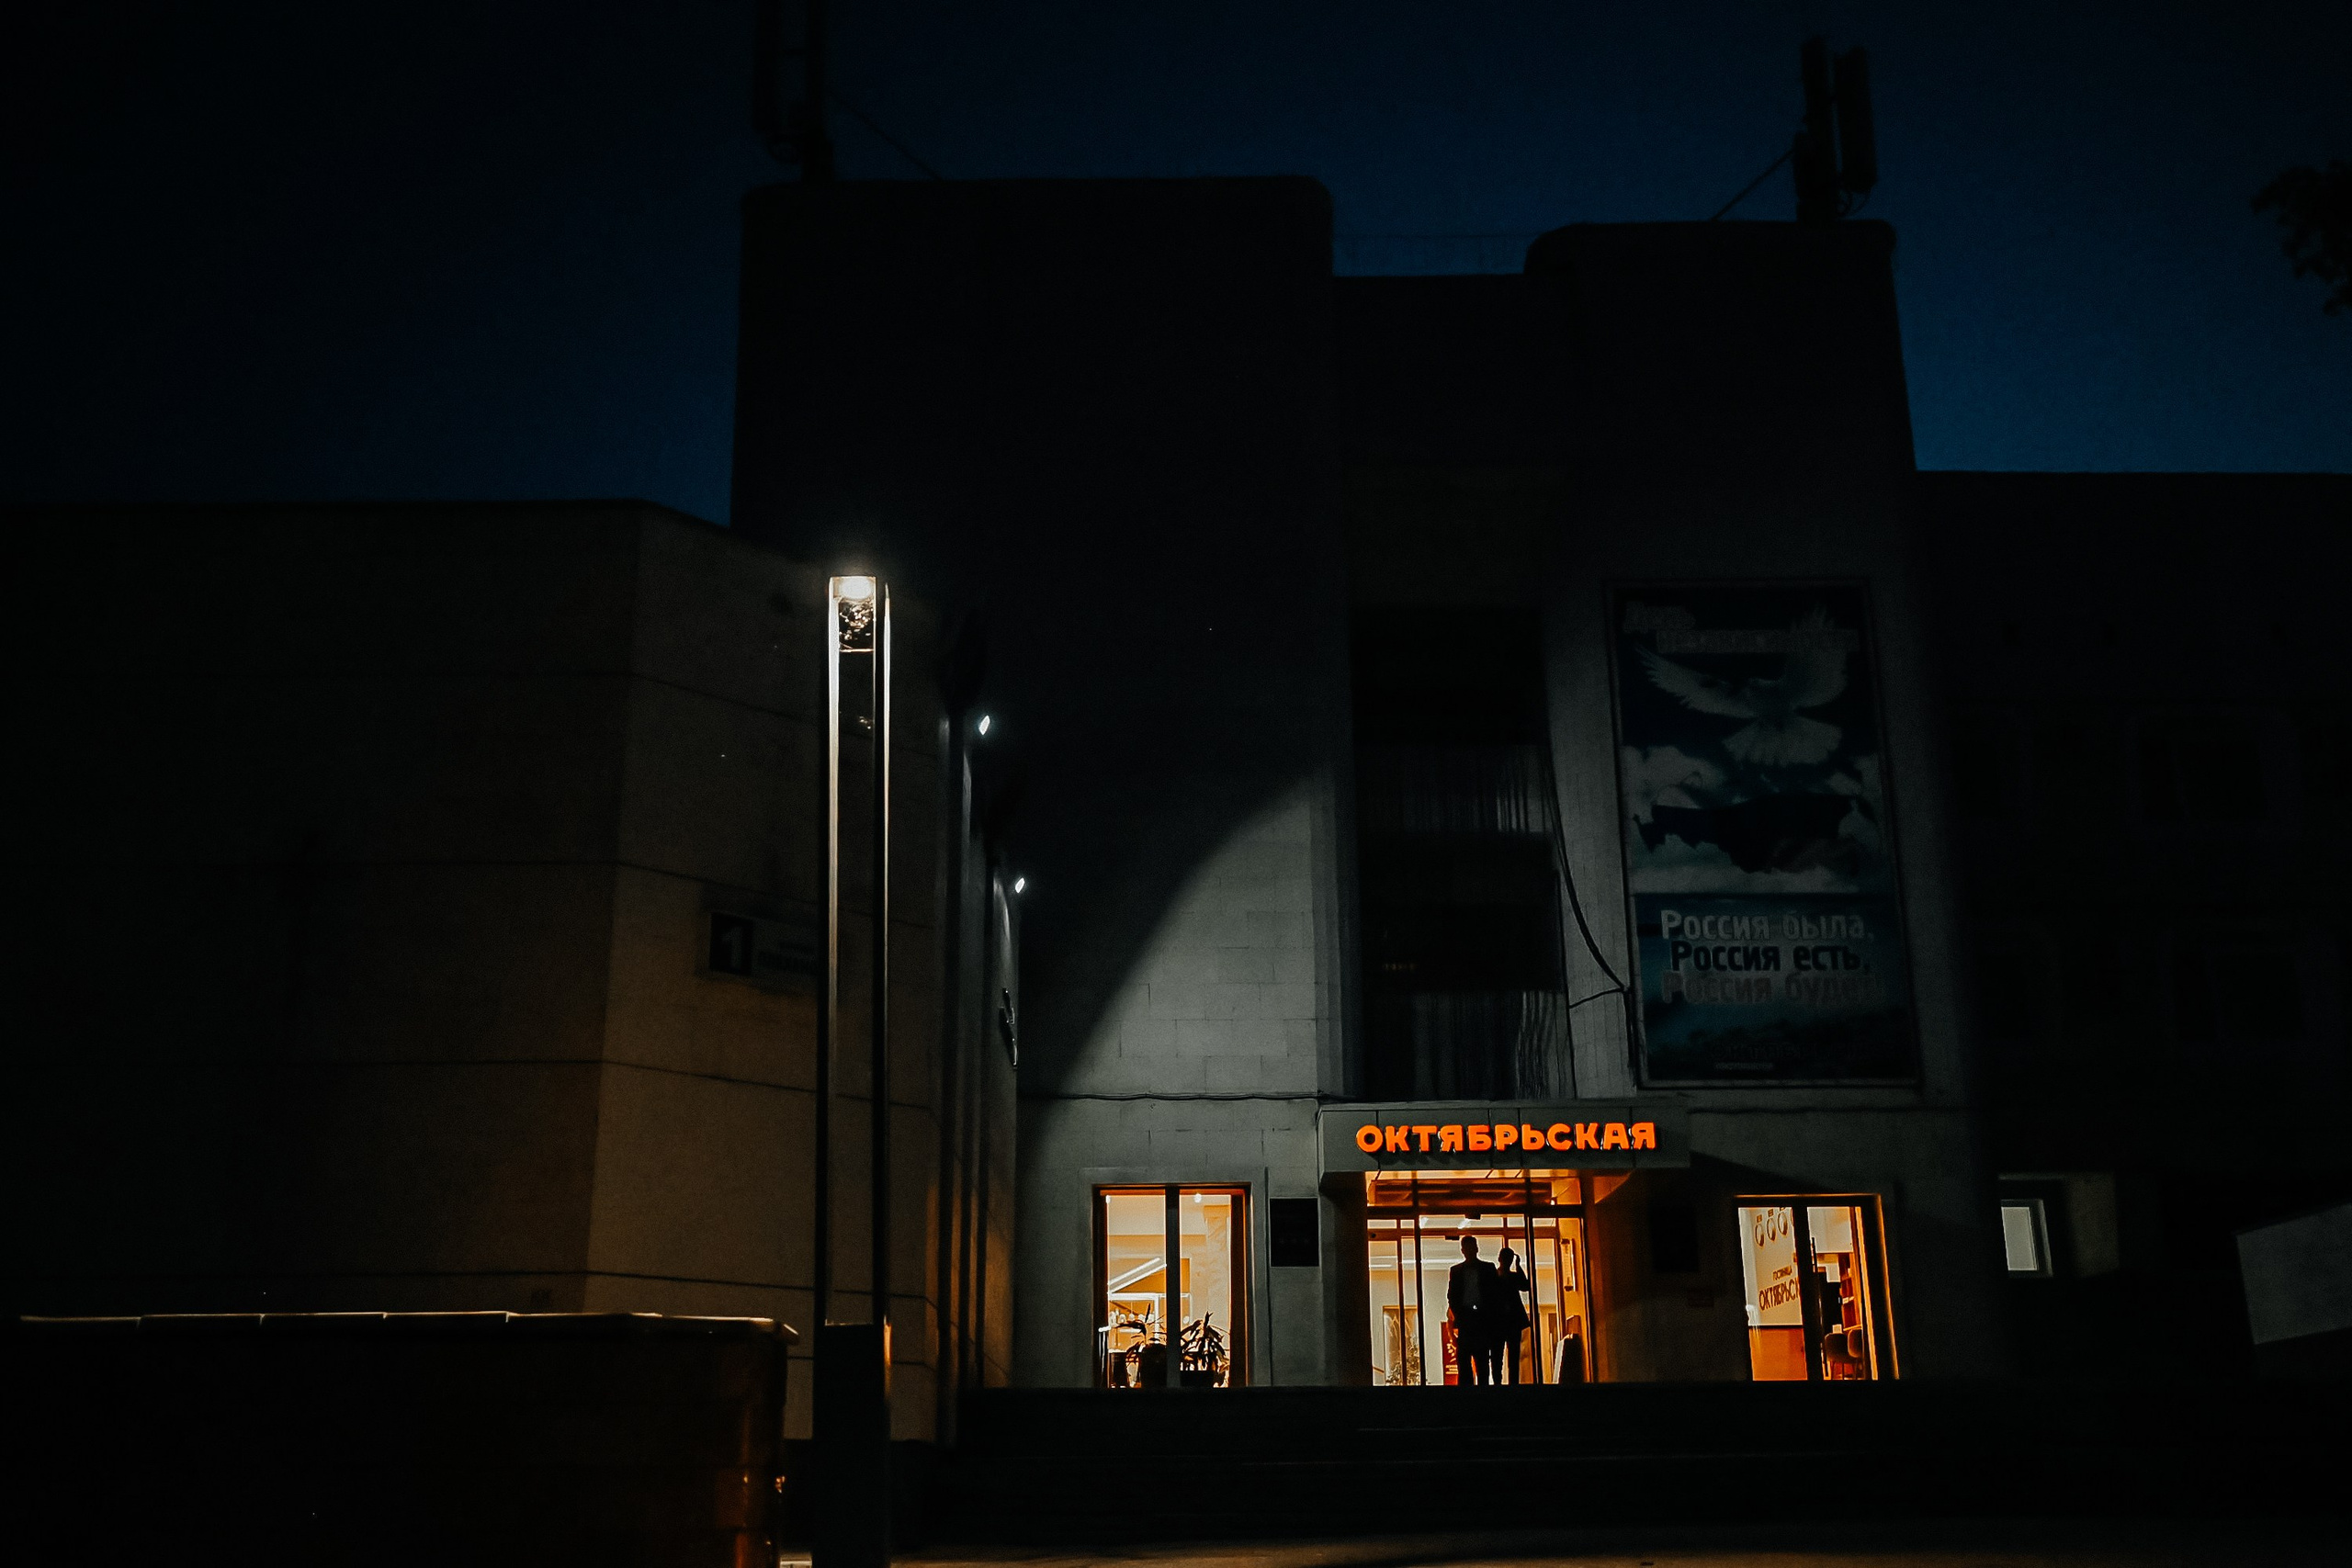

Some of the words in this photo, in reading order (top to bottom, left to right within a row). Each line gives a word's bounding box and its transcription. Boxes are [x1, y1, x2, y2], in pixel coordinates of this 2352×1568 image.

[1660, 909, 1771, 942] Россия
[719, 926, 742, 969] 1
[1671, 941, 1781, 972] Россия
[1792, 944, 1871, 975] есть,
[1661, 970, 1773, 1004] Россия
[1355, 1122, 1656, 1153] ОКТЯБРЬСКАЯ
